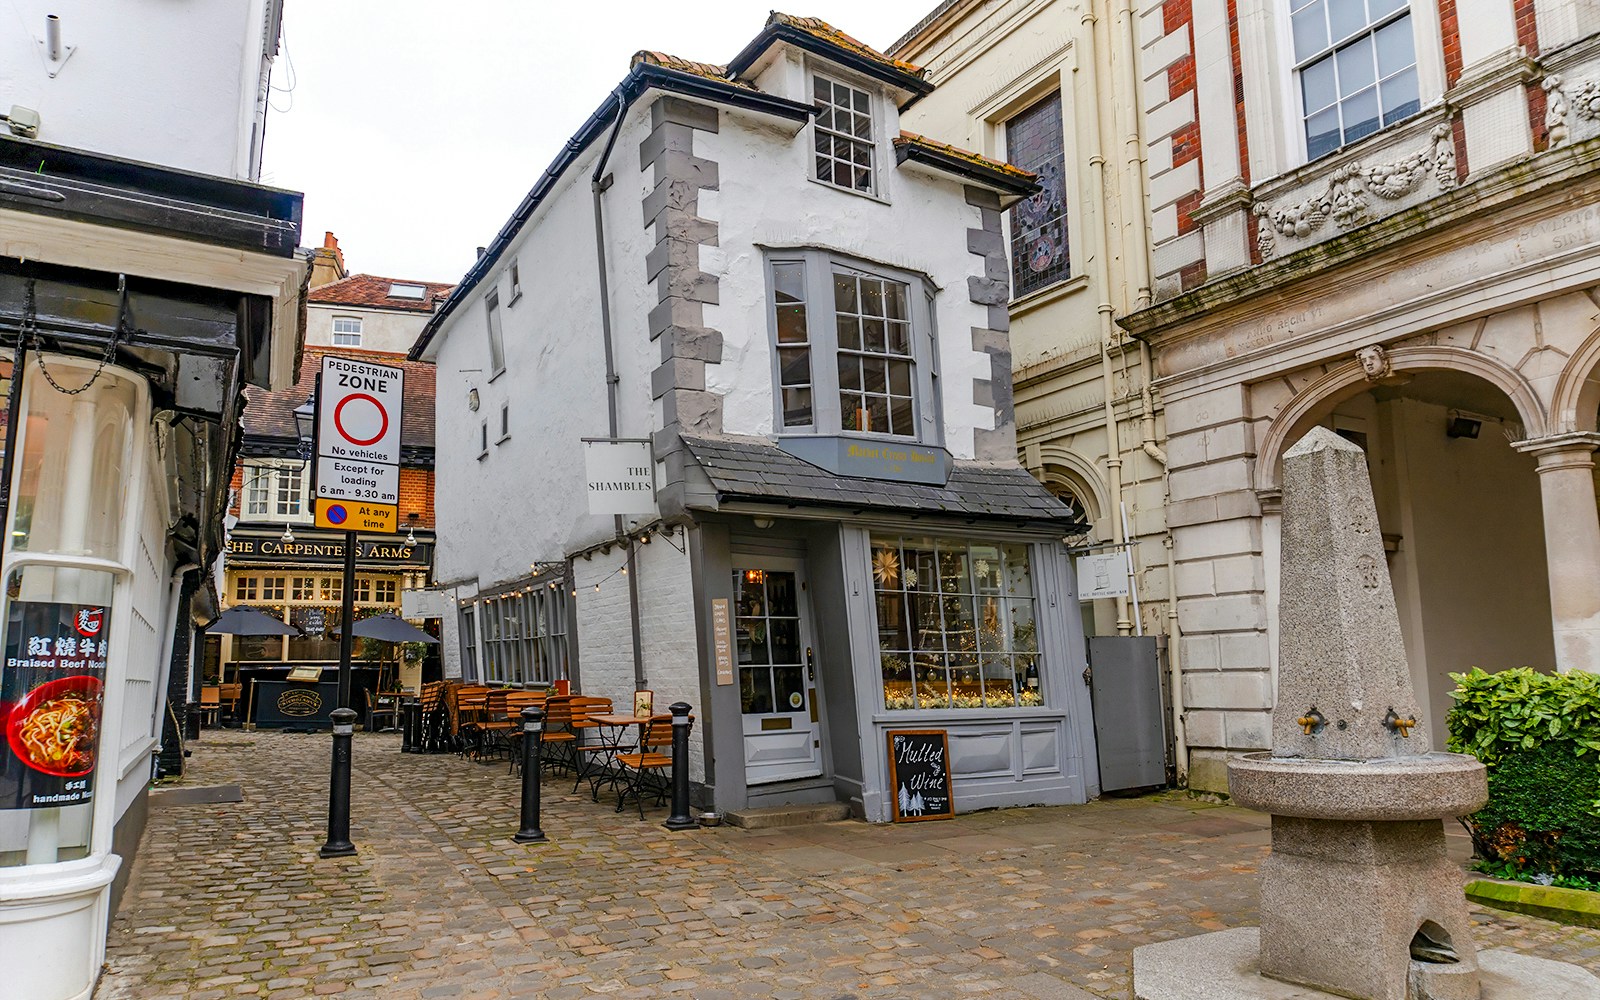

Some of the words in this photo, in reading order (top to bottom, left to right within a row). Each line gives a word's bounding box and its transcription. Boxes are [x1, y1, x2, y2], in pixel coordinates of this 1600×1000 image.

[328, 361, 398, 380] PEDESTRIAN
[338, 374, 388, 393] ZONE
[331, 446, 346, 455] No
[349, 449, 388, 461] vehicles
[334, 462, 368, 474] Except
[371, 466, 384, 475] for
[627, 467, 651, 476] THE
[341, 475, 377, 488] loading
[588, 482, 652, 491] SHAMBLES
[320, 485, 327, 493] 6
[355, 488, 379, 499] 9.30
[358, 507, 371, 516] At
[373, 509, 390, 518] any
[363, 519, 385, 529] time
[261, 541, 362, 558] CARPENTES
[368, 545, 413, 559] ARMS
[7, 658, 56, 668] Braised
[60, 660, 85, 669] Beef
[898, 740, 944, 764] Mulled
[910, 772, 944, 790] Wine
[33, 792, 80, 803] handmade
